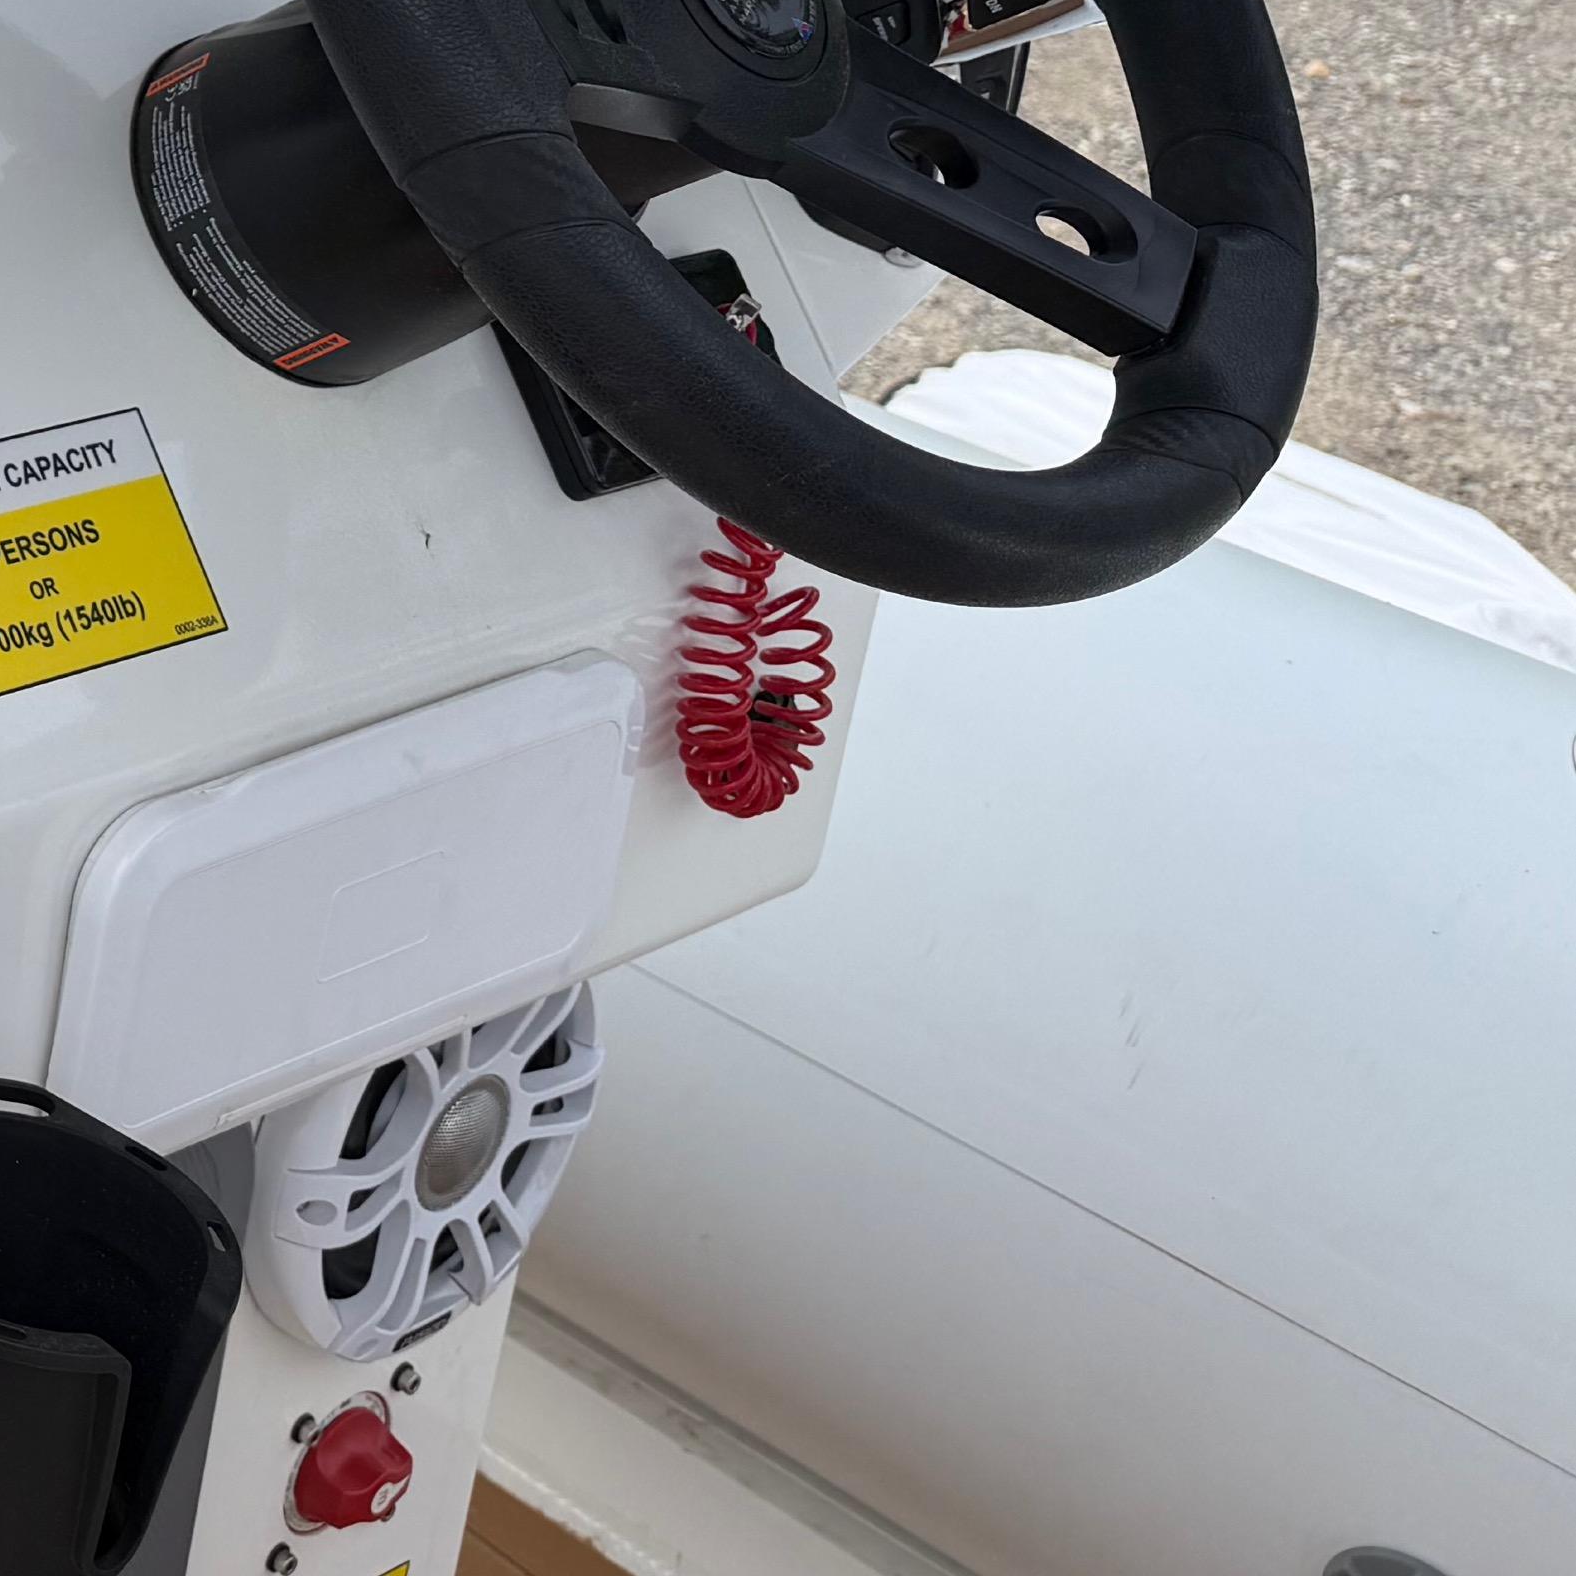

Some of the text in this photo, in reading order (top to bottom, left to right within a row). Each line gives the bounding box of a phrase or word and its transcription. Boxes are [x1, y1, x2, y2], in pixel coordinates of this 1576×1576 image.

[3, 439, 118, 488] CAPACITY
[29, 576, 59, 600] OR
[57, 590, 146, 642] (1540lb)
